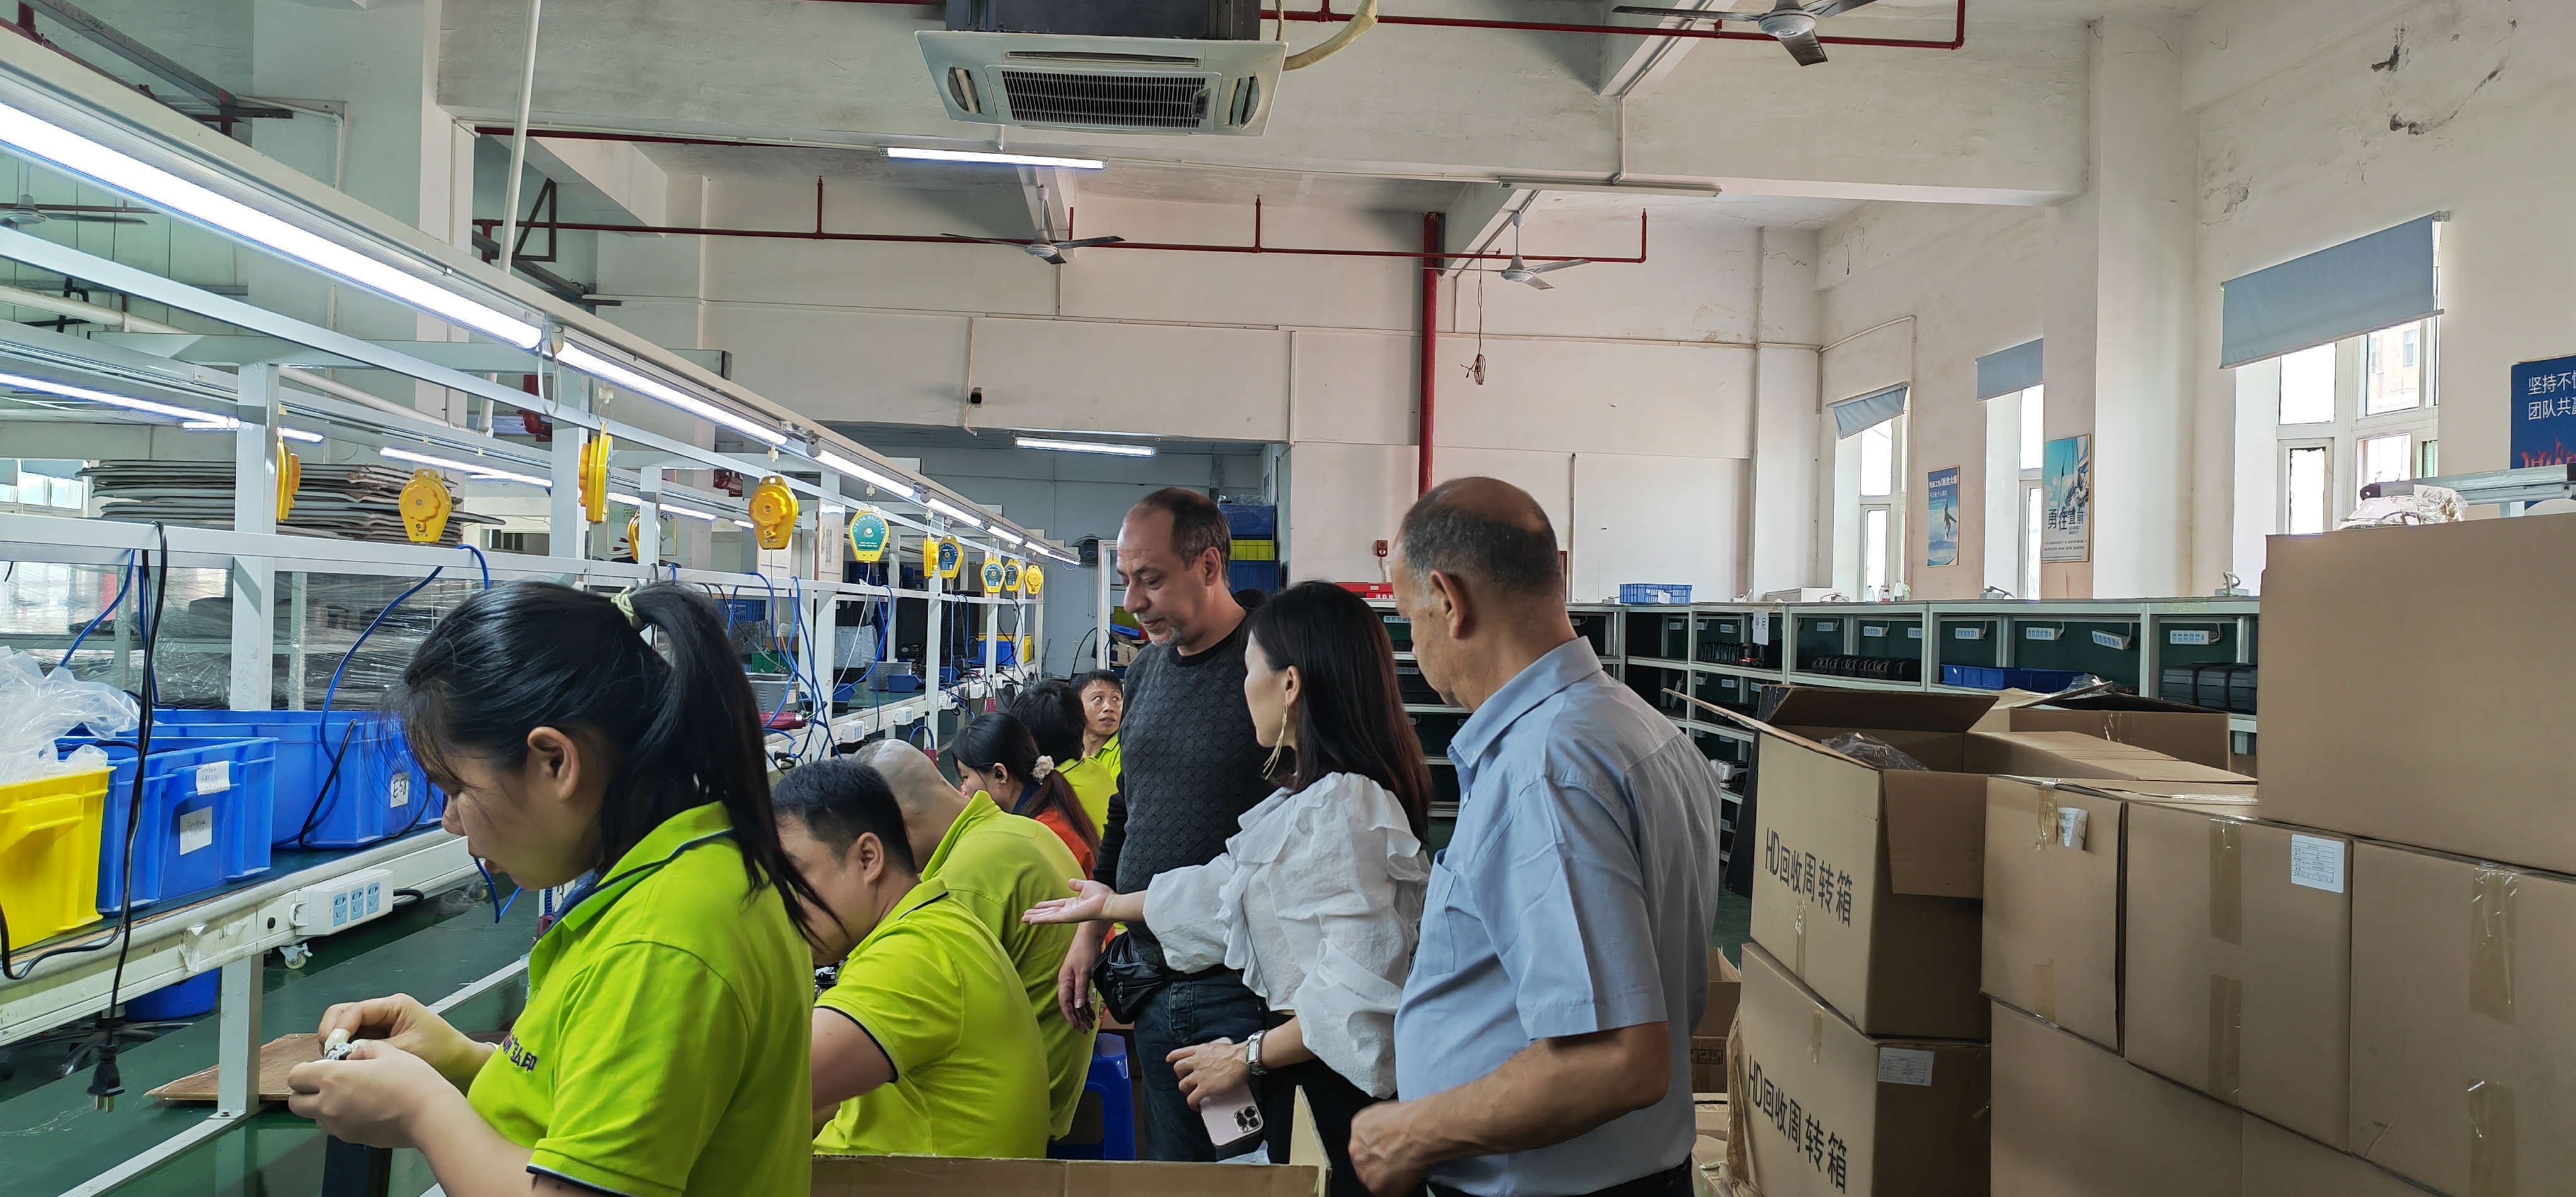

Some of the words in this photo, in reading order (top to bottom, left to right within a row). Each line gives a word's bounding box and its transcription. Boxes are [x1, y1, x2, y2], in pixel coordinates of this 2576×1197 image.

[2048, 509, 2084, 531] 勇往直前
[1765, 827, 1852, 928] HD回收周转箱
[1748, 1054, 1846, 1194] HD回收周转箱
